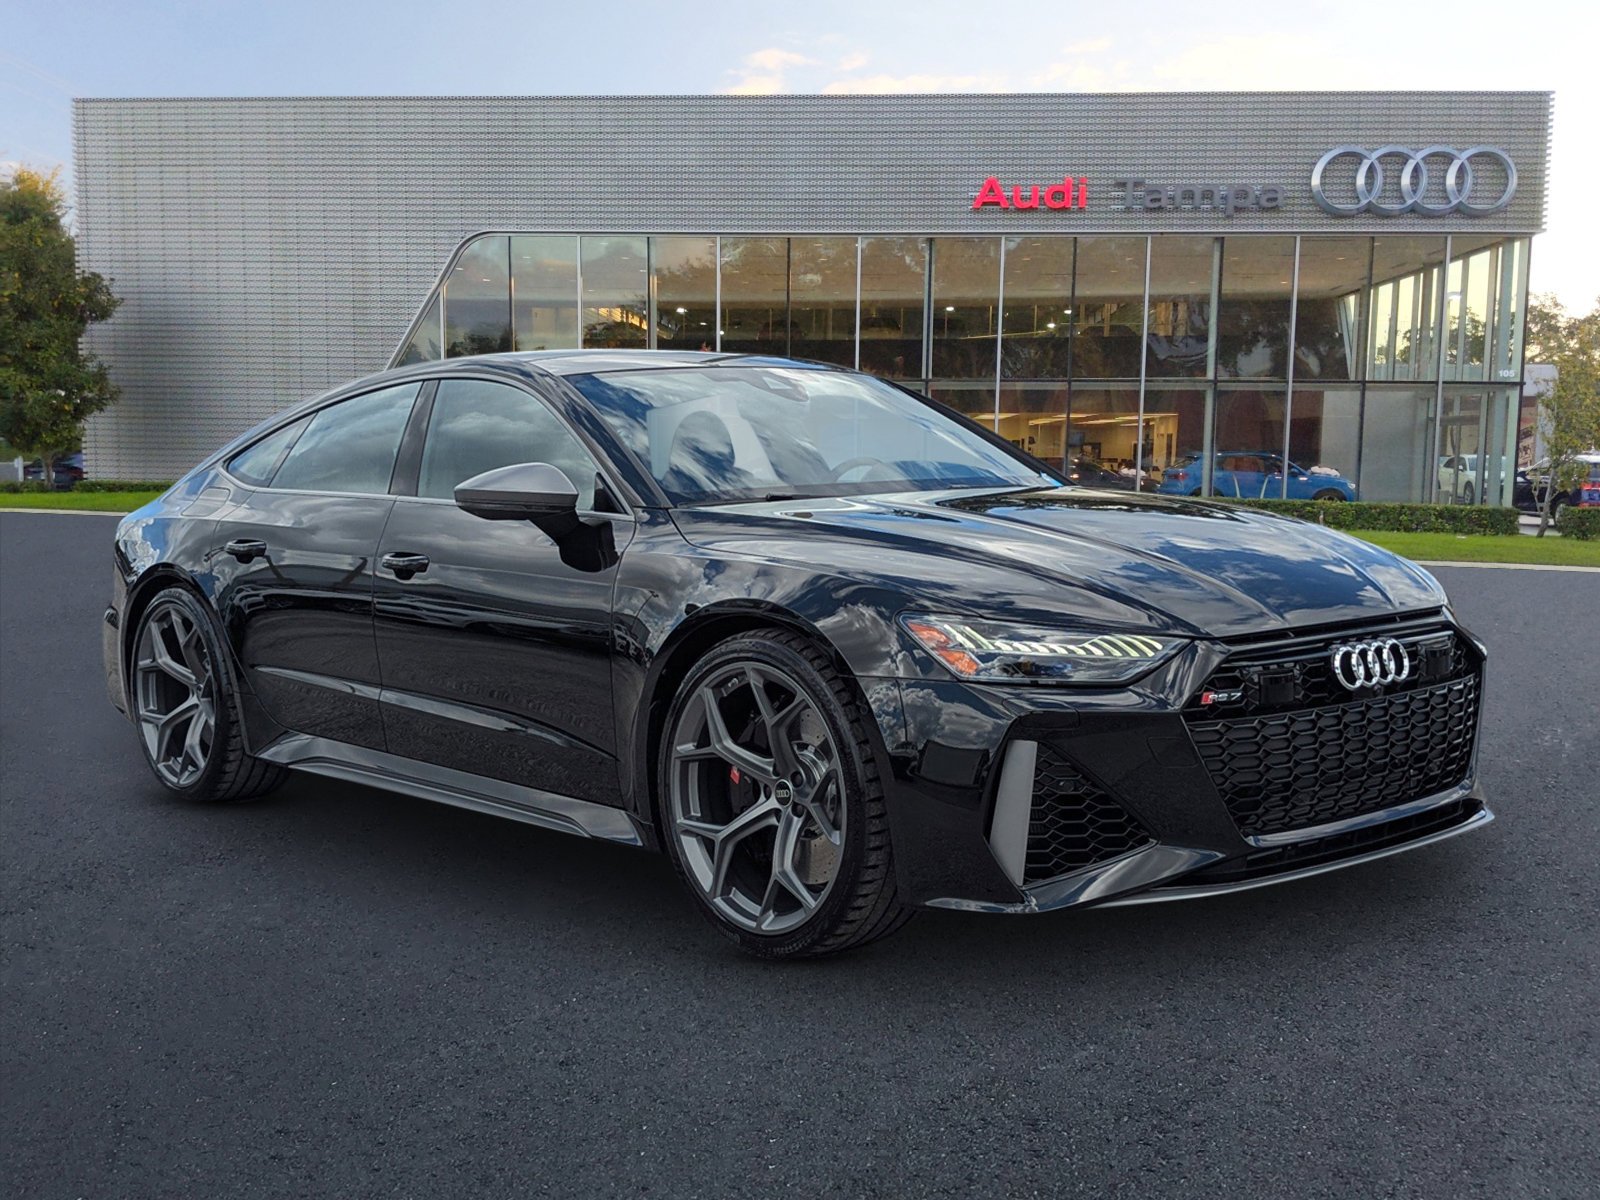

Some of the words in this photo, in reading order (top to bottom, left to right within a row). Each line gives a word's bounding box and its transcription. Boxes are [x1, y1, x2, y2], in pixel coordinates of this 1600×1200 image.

[972, 176, 1088, 209] Audi
[1113, 178, 1285, 218] Tampa
[1499, 369, 1515, 378] 105
